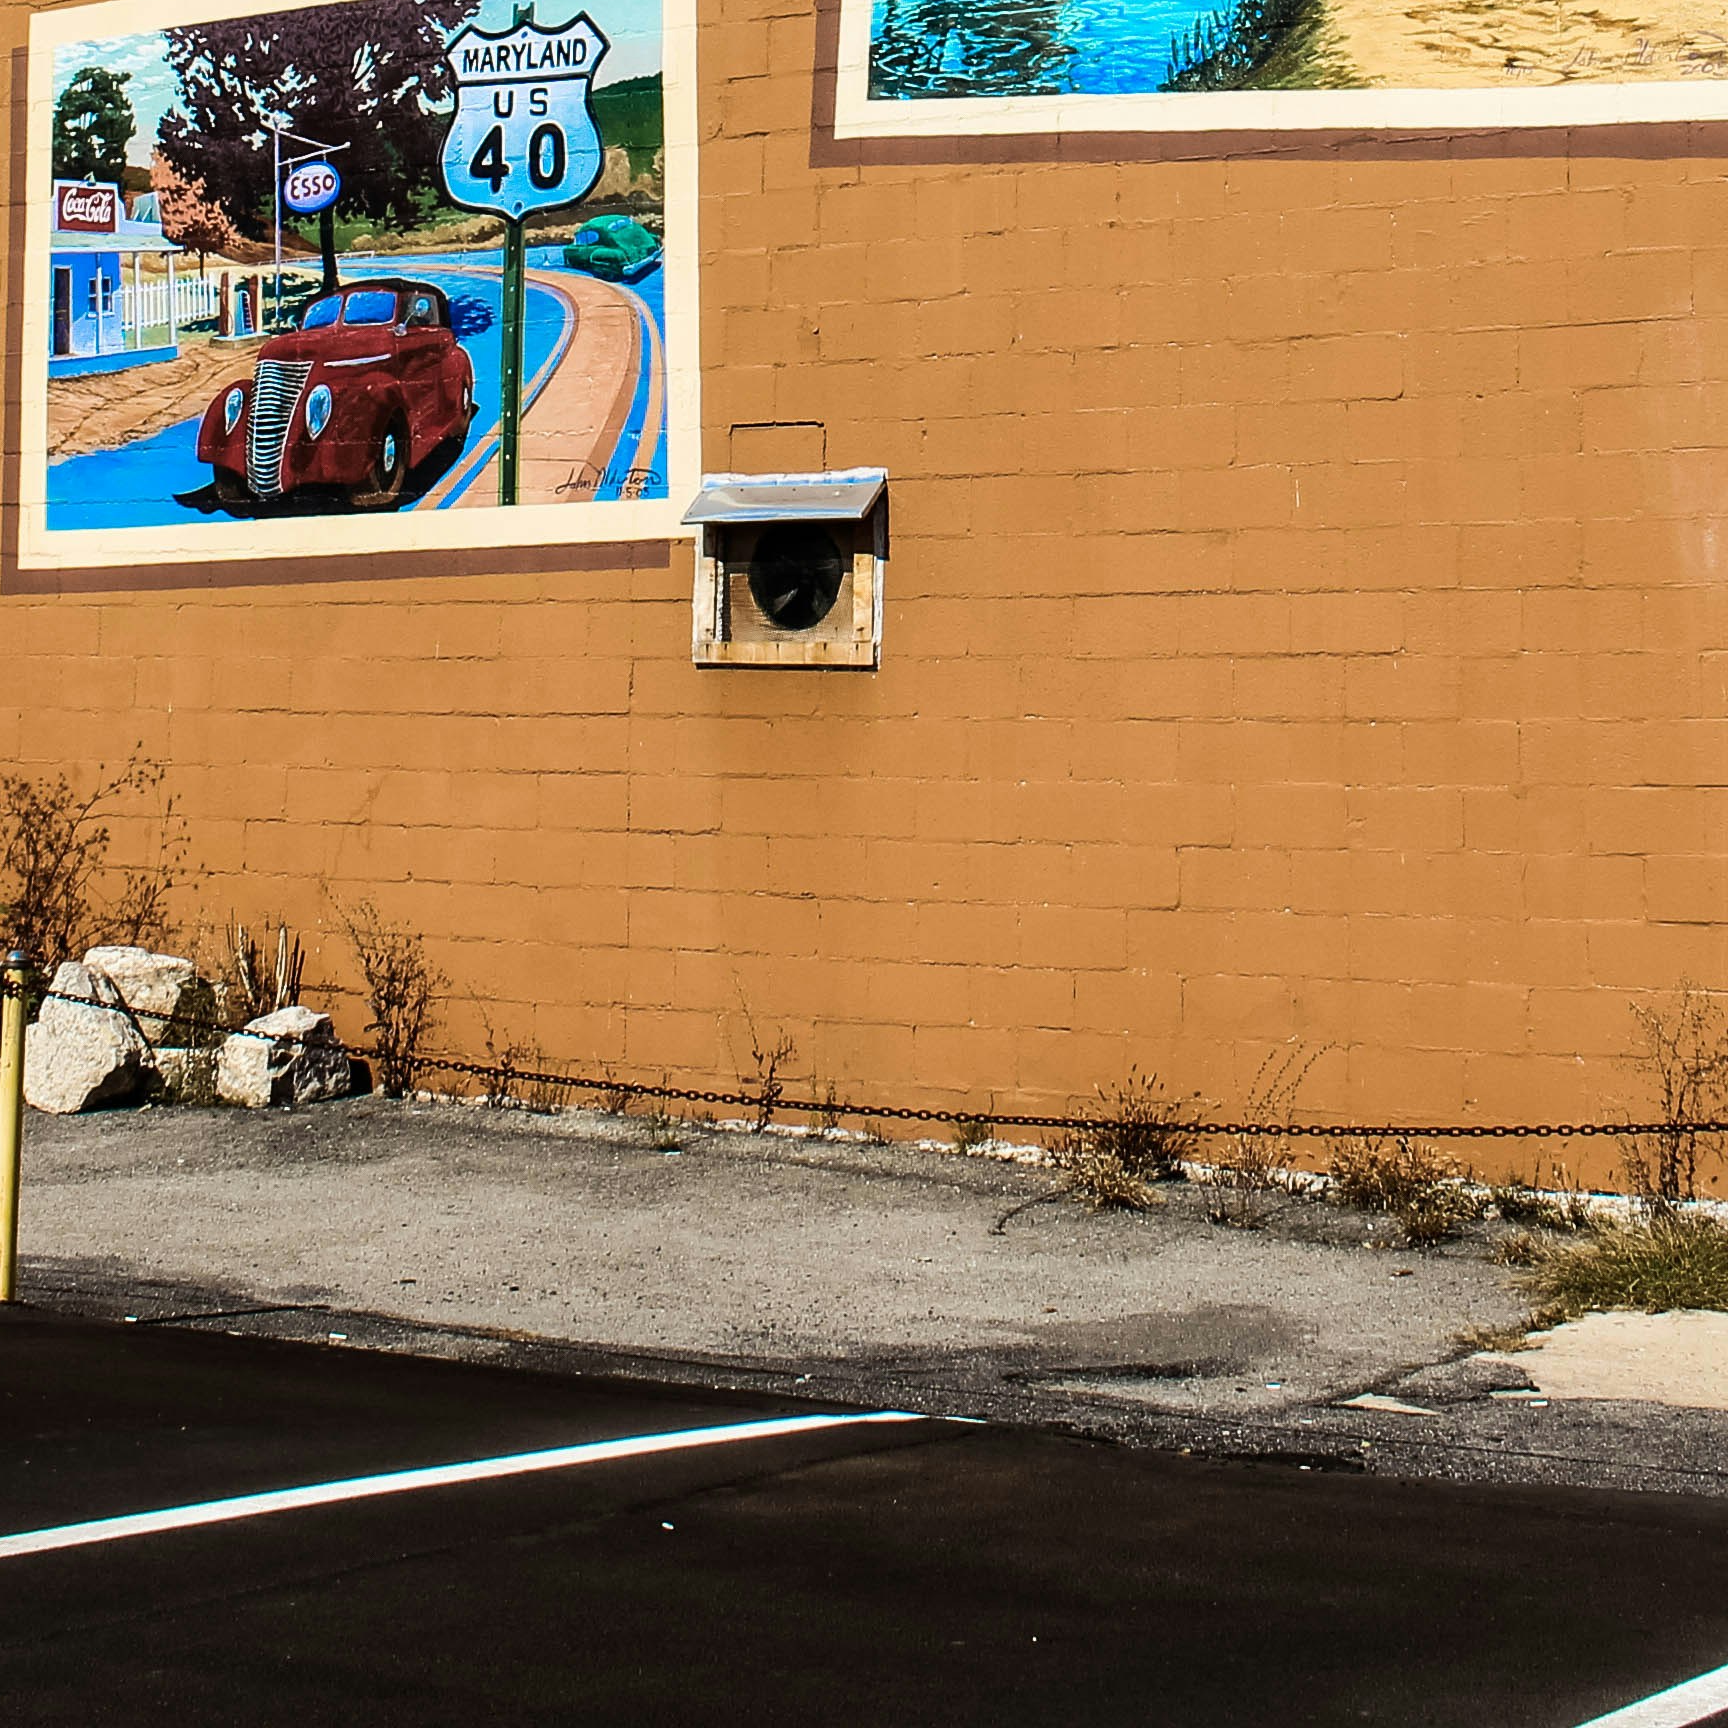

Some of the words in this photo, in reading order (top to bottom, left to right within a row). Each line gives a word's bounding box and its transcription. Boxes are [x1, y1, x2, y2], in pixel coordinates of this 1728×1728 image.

[462, 38, 587, 73] MARYLAND
[469, 122, 566, 195] 40
[290, 174, 335, 200] ESSO
